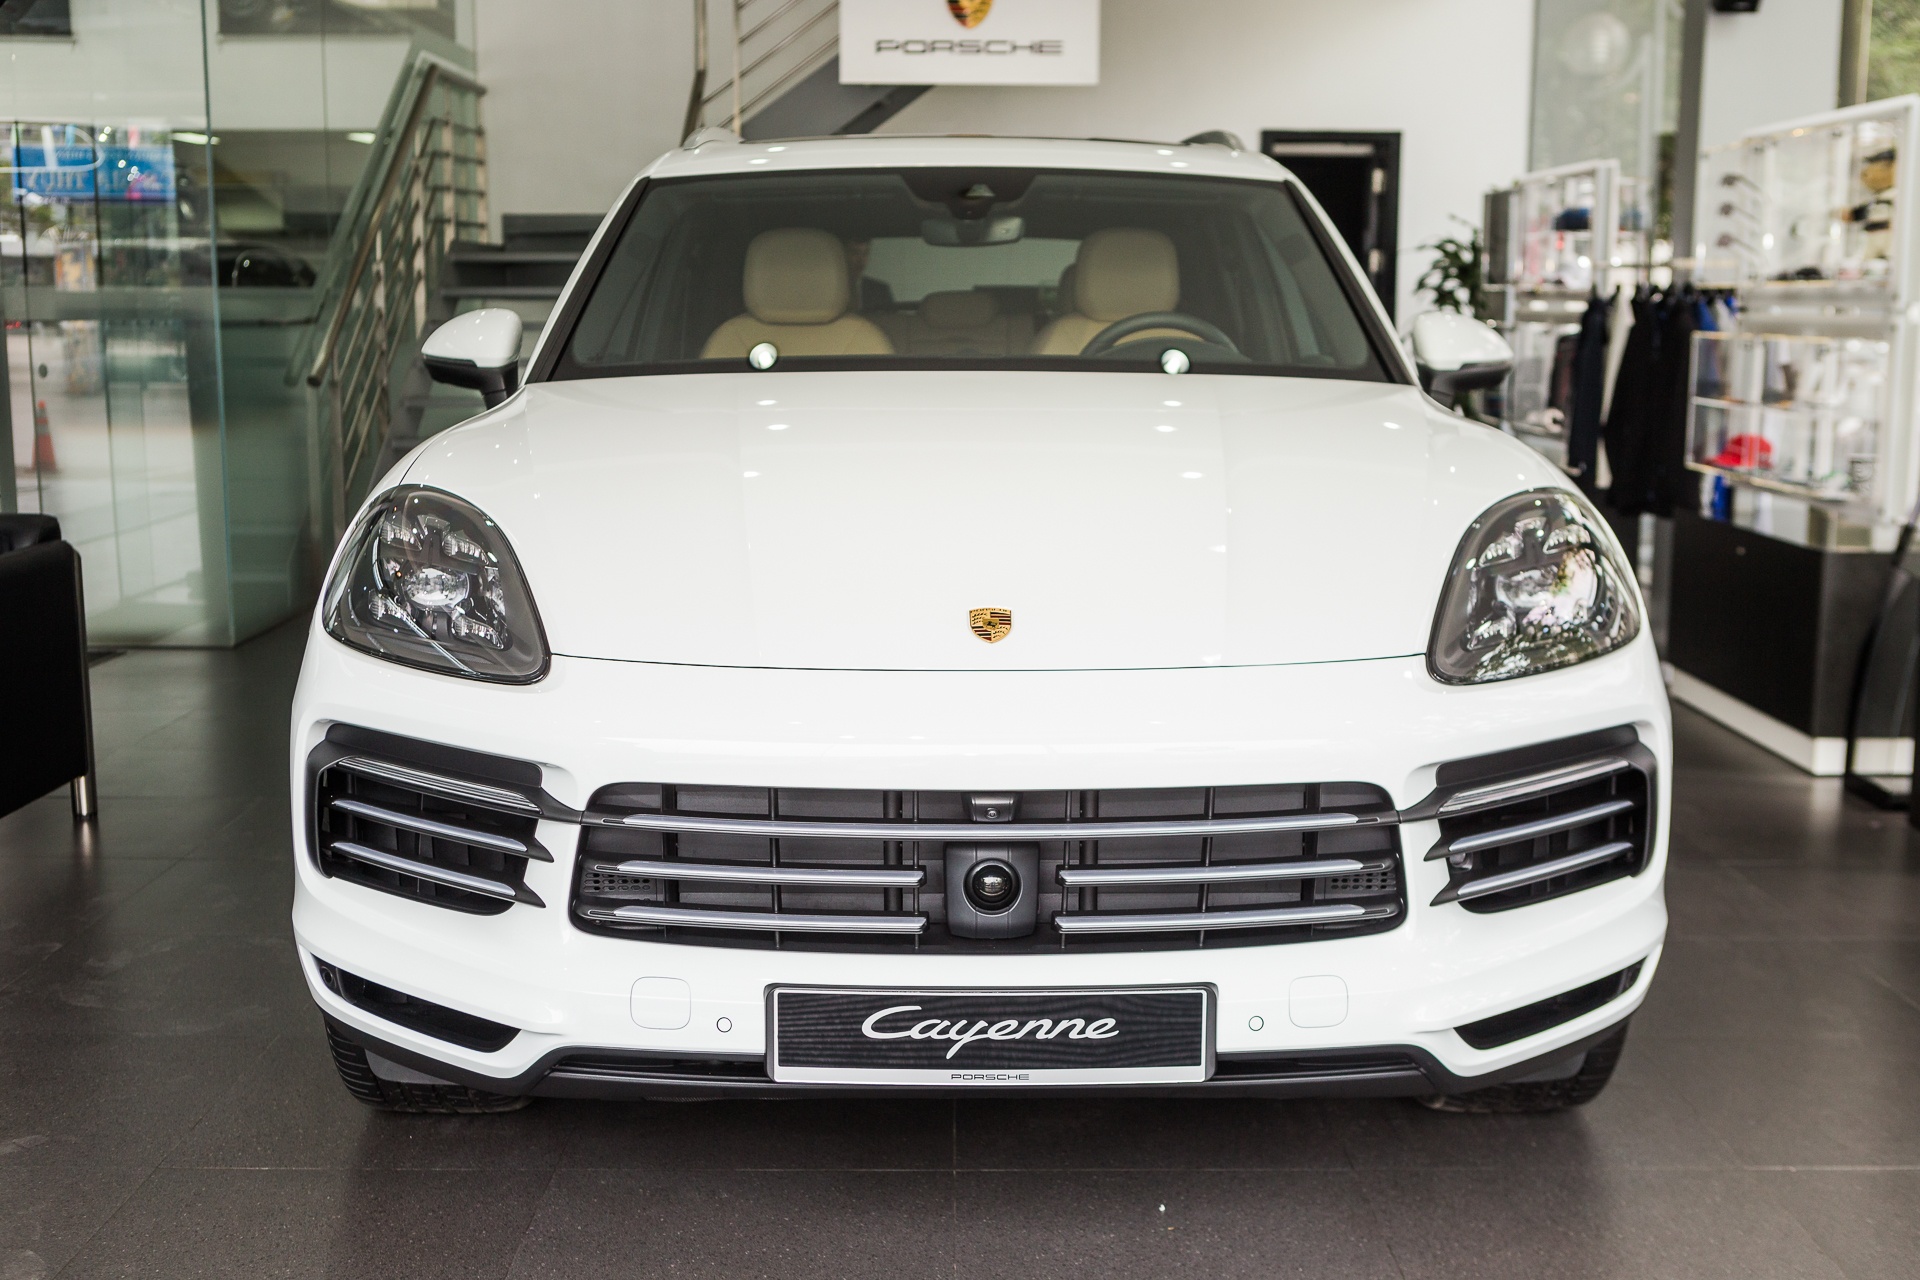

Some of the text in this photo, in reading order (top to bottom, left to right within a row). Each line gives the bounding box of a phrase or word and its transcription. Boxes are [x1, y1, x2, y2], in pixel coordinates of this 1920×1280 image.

[875, 39, 1064, 55] PORSCHE
[861, 1005, 1120, 1060] Cayenne
[950, 1073, 1030, 1081] PORSCHE
